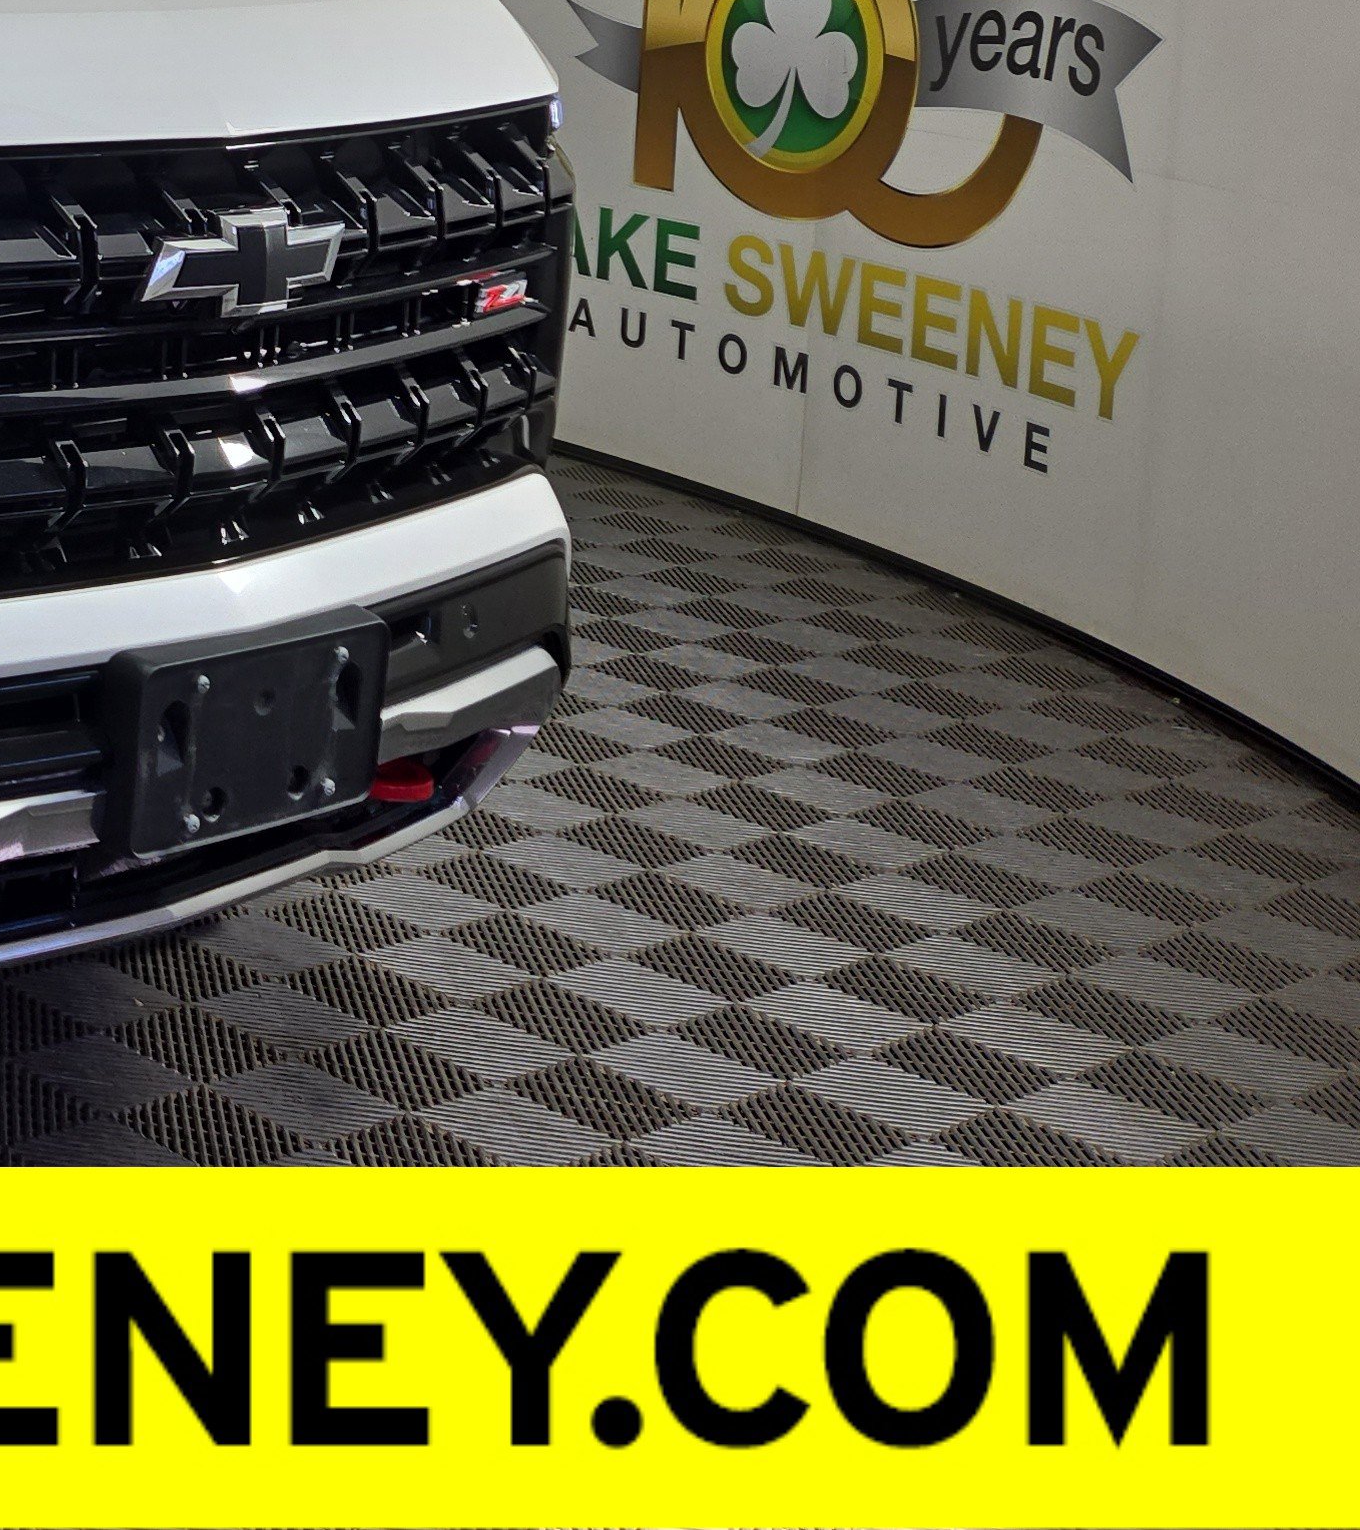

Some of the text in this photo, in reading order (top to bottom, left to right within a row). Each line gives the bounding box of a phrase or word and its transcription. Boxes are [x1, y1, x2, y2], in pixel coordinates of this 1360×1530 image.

[928, 8, 1105, 96] years
[568, 298, 1051, 474] AUTOMOTIVE
[724, 234, 1140, 421] SWEENEY
